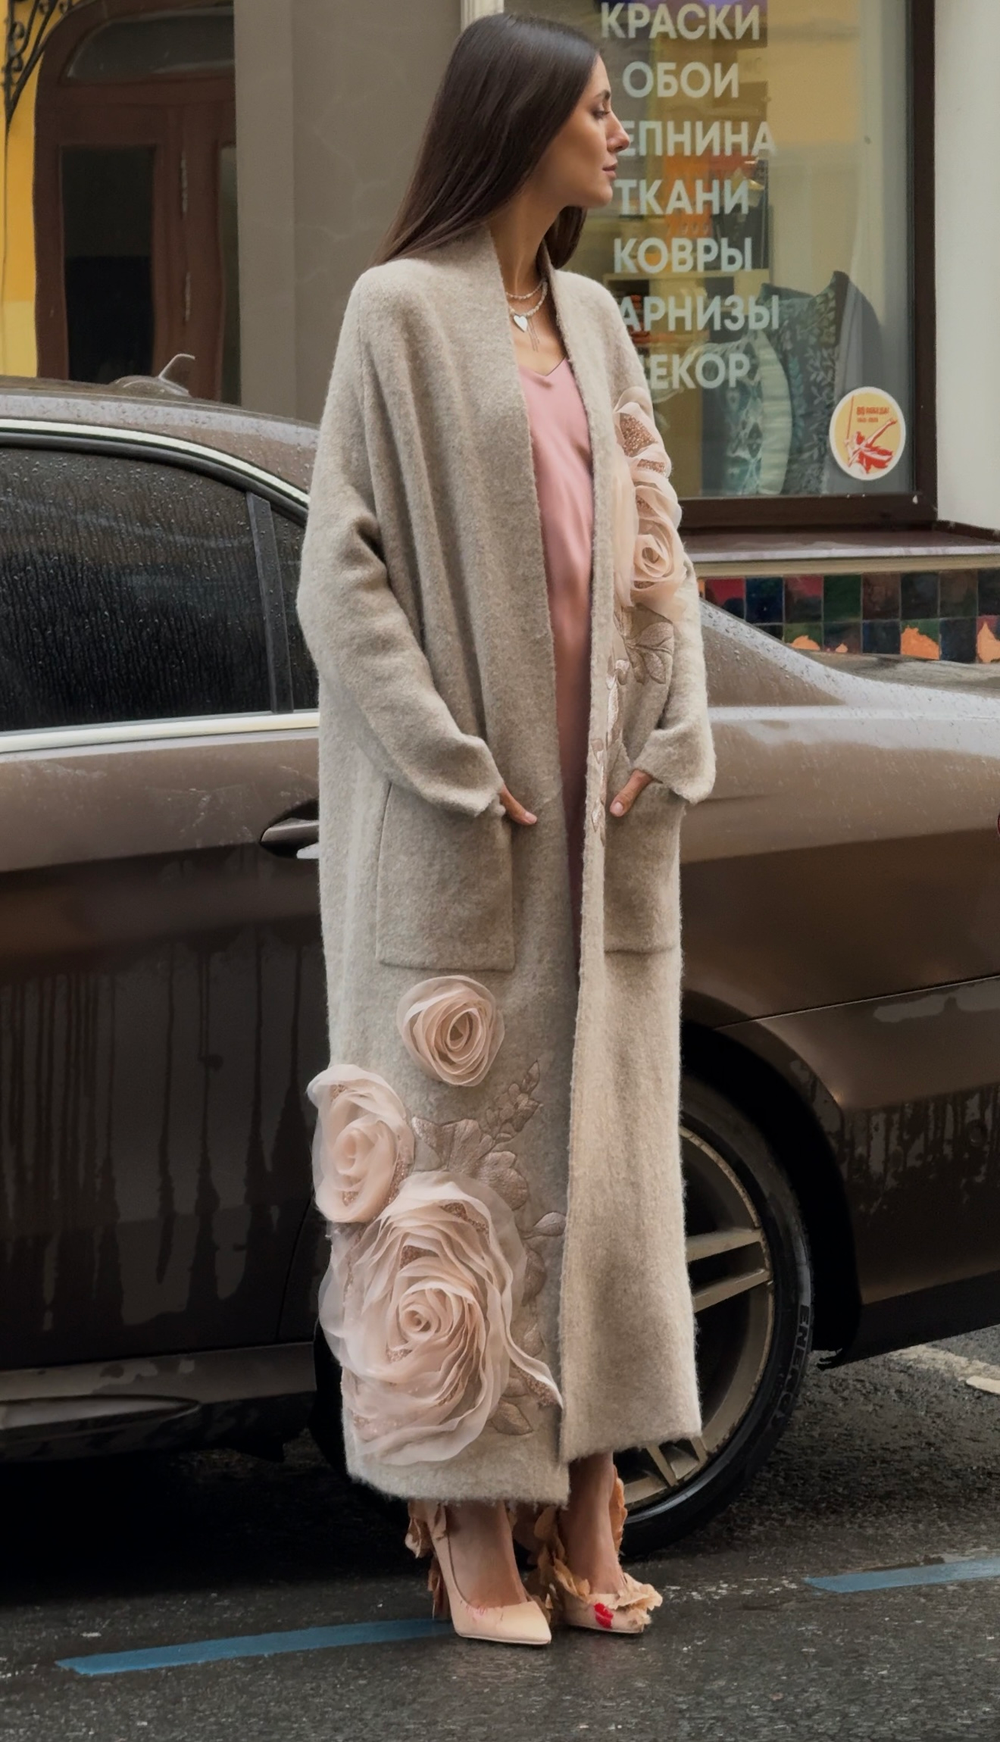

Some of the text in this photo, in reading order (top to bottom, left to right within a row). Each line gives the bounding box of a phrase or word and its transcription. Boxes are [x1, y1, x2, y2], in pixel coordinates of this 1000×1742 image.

[601, 3, 760, 40] КРАСКИ
[622, 61, 739, 98] ОБОИ
[618, 121, 777, 157] ЕПНИНА
[614, 179, 749, 215] ТКАНИ
[613, 237, 752, 274] КОВРЫ
[619, 294, 779, 332] АРНИЗЫ
